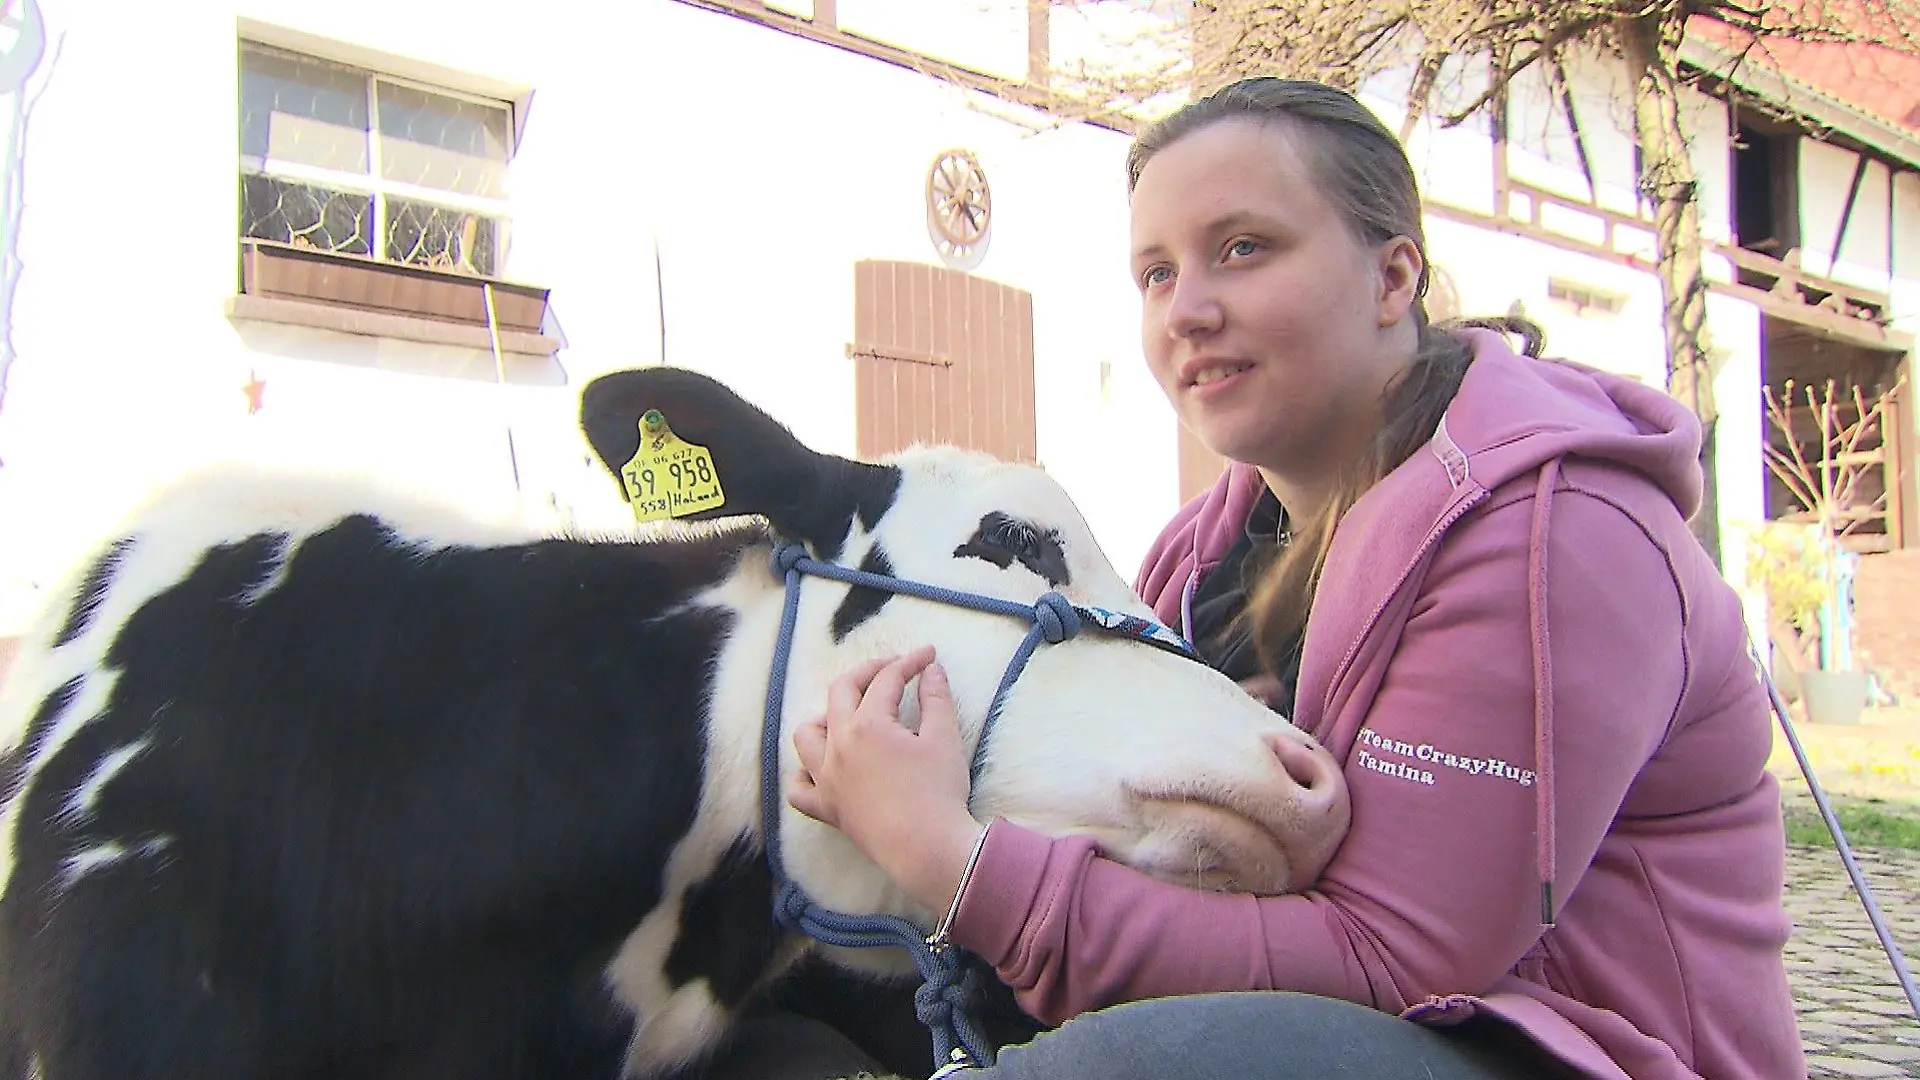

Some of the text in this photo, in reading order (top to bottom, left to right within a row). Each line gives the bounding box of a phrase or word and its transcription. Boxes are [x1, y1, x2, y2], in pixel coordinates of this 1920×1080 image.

[626, 456, 711, 498] 39 958
[1357, 750, 1435, 785] Tamina
